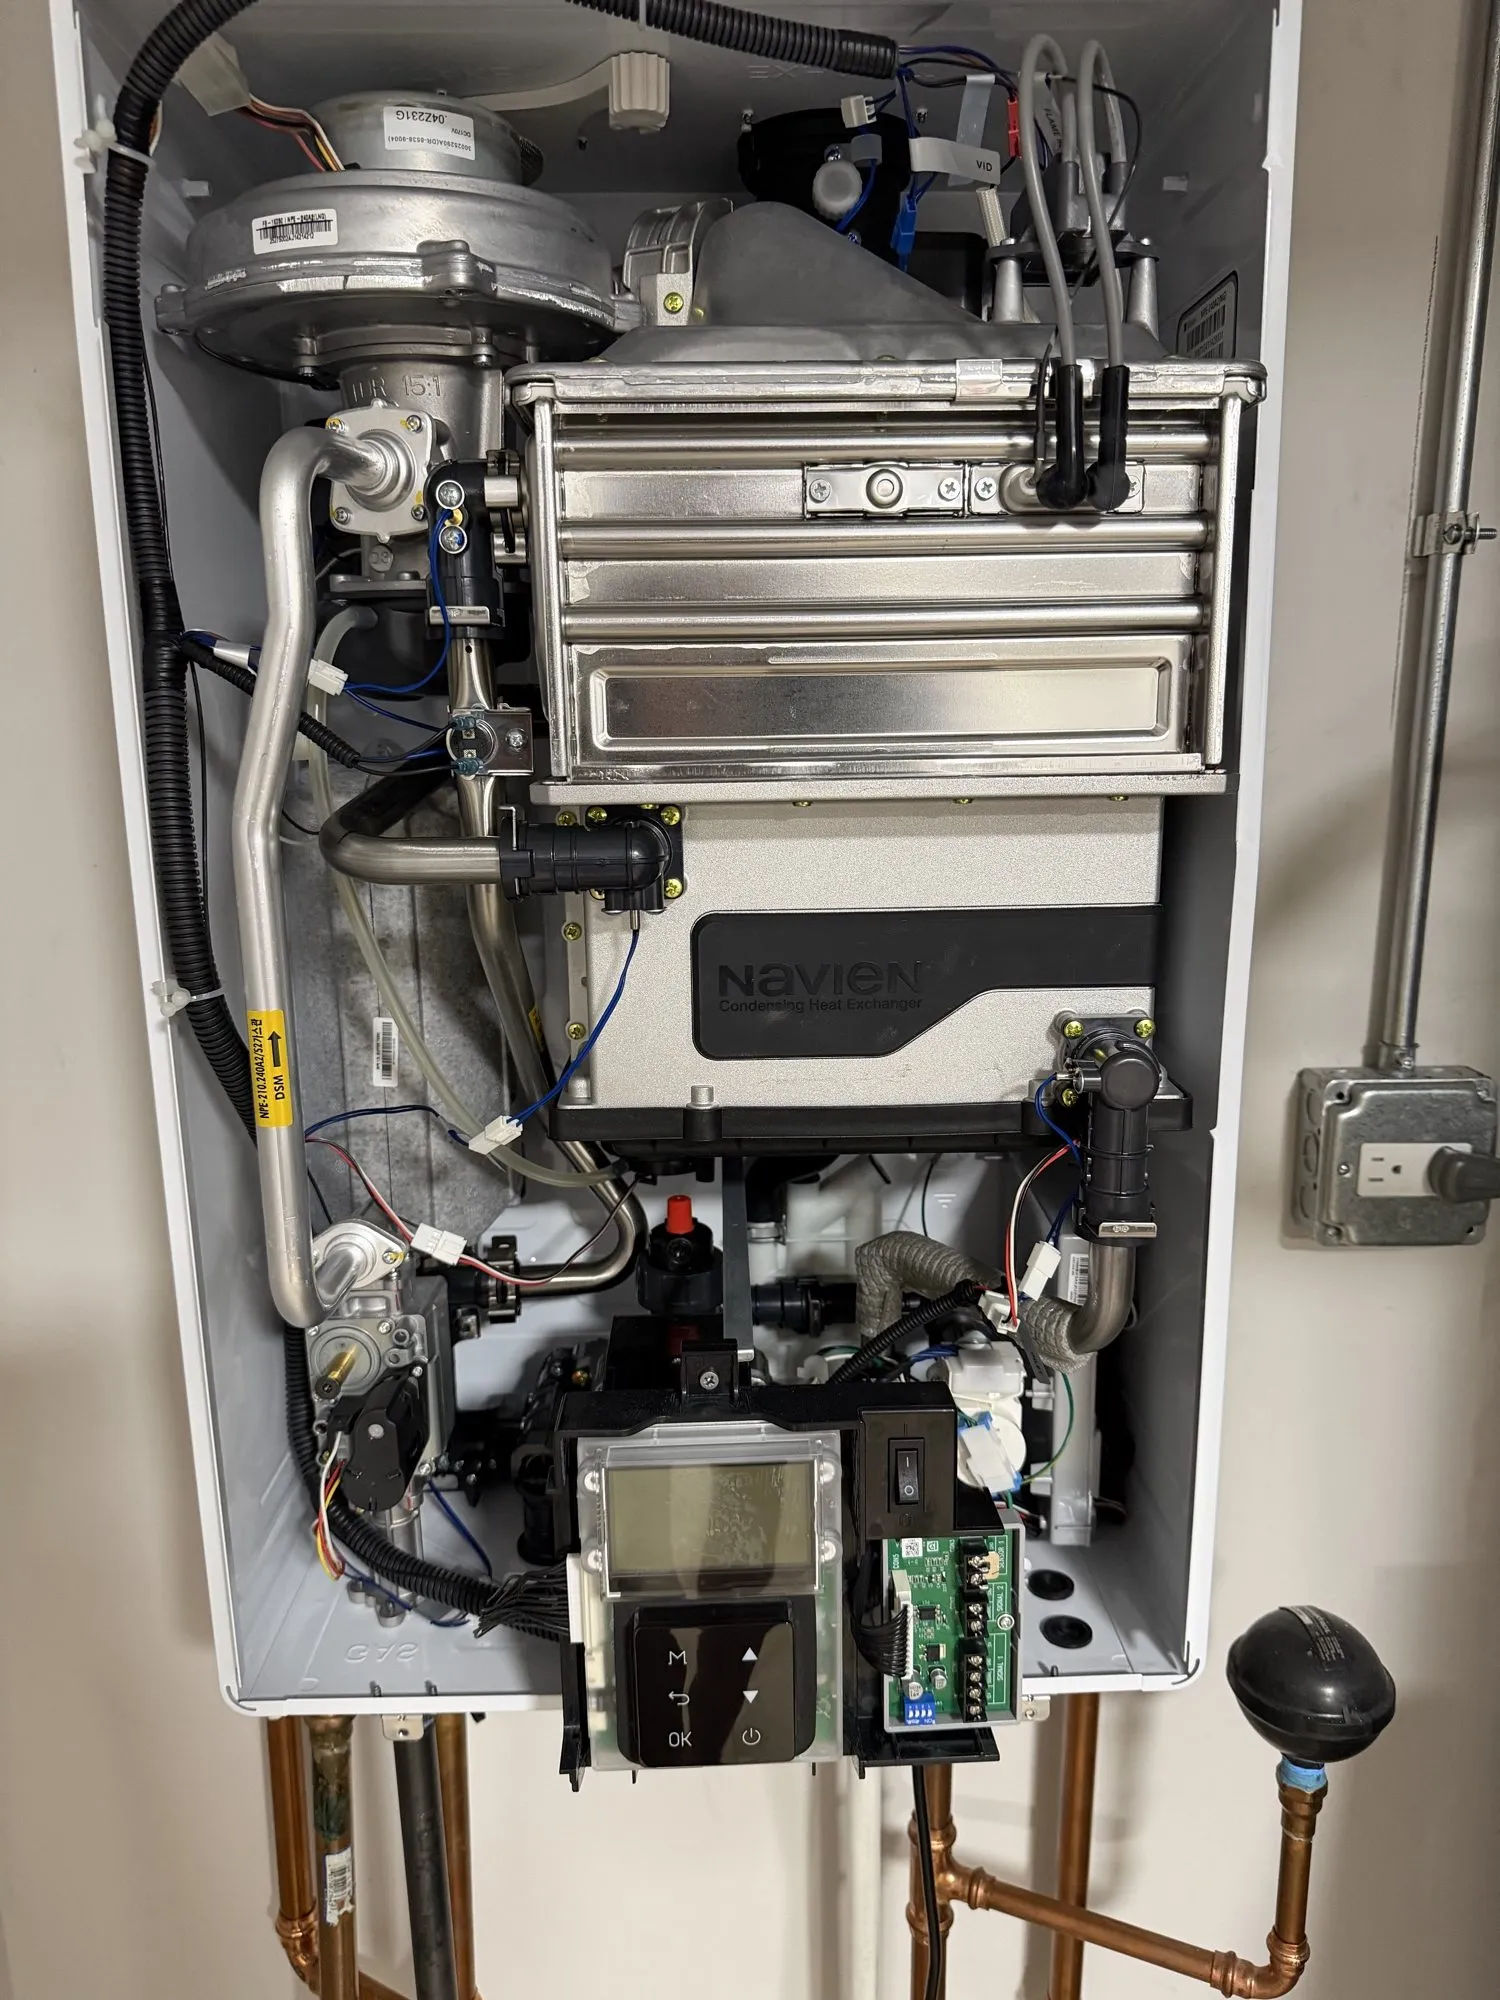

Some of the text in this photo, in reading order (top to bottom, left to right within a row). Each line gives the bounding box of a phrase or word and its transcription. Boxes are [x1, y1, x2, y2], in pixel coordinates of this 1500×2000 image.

[976, 159, 993, 172] VID
[403, 374, 441, 397] 15:1
[719, 997, 923, 1014] Condensing Heat Exchanger
[273, 1074, 286, 1100] DSM
[668, 1650, 687, 1665] M
[668, 1731, 692, 1747] OK
